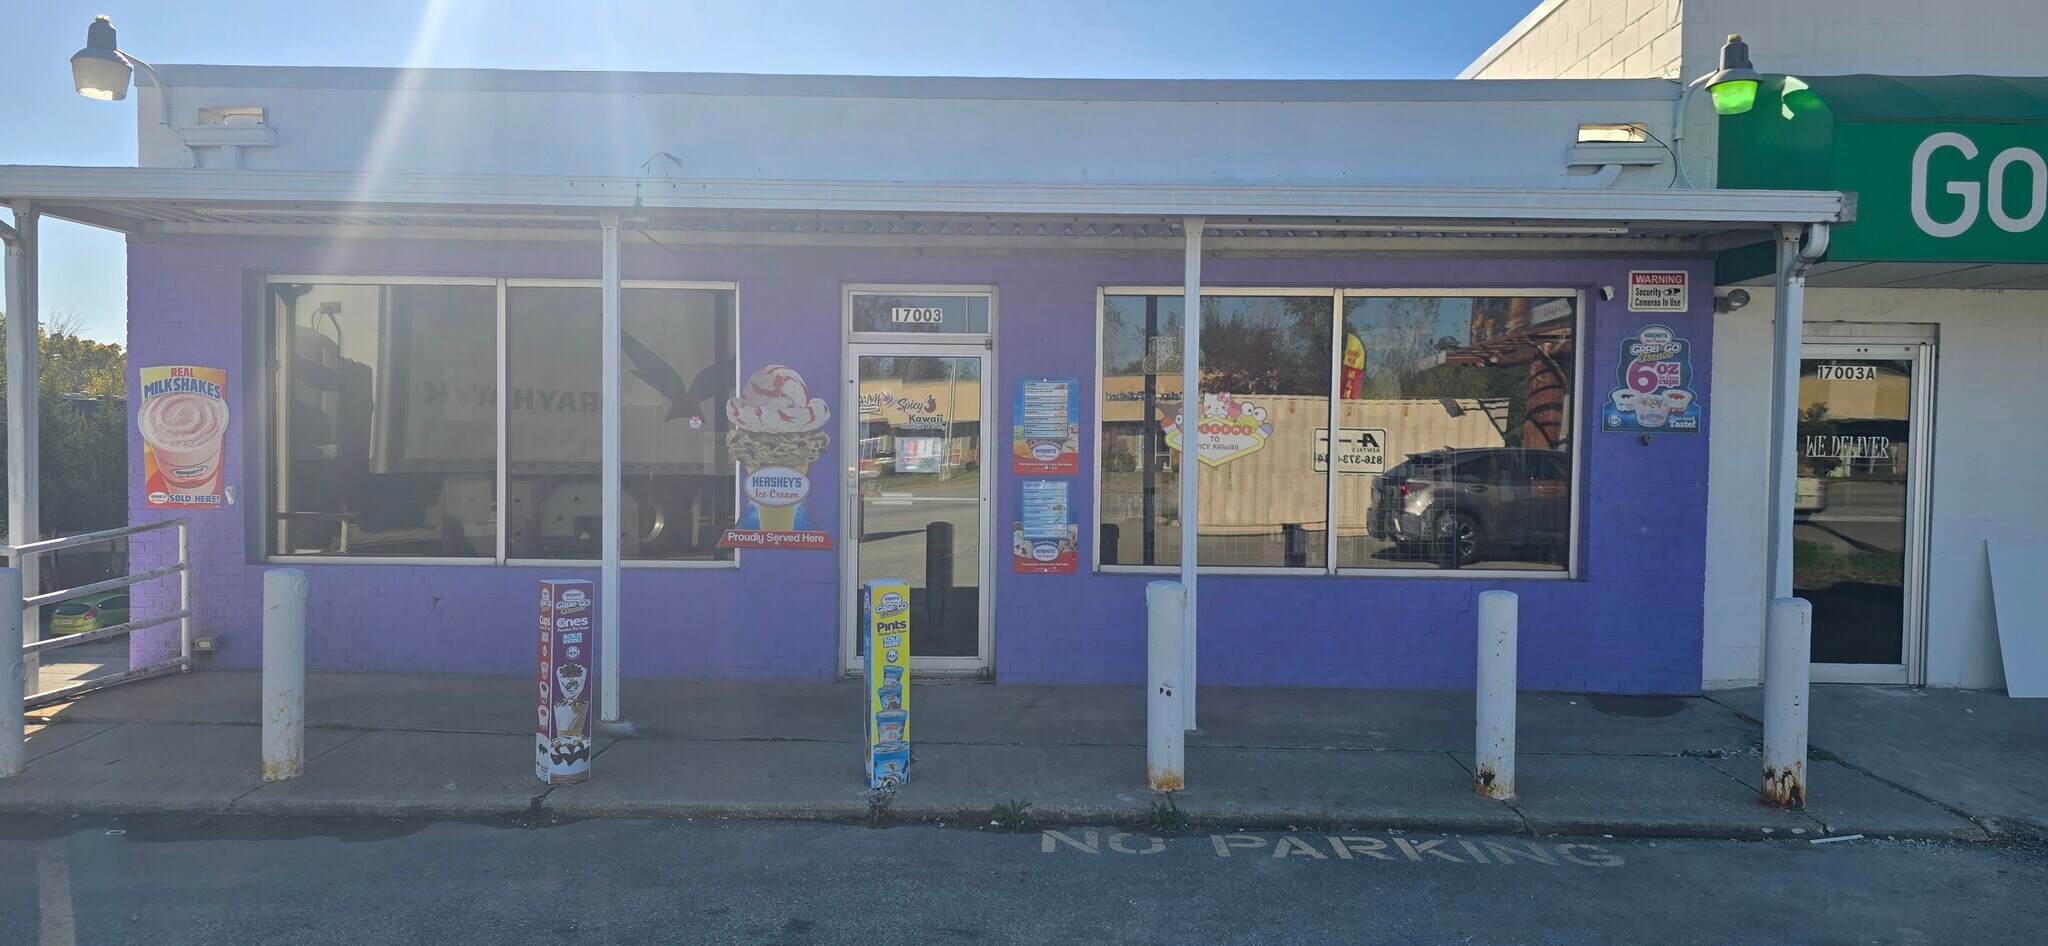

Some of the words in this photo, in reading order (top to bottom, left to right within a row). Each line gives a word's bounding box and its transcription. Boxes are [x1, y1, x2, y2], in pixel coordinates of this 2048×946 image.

[1635, 275, 1683, 284] WARNING
[1635, 287, 1661, 297] Security
[1635, 298, 1661, 307] Cameras
[1670, 299, 1681, 307] Use
[894, 308, 942, 322] 17003
[1632, 345, 1660, 354] GRAB
[1664, 344, 1680, 352] GO
[170, 367, 194, 378] REAL
[1629, 359, 1659, 394] 6
[1819, 366, 1875, 380] 17003A
[144, 377, 222, 400] MILKSHAKES
[1659, 379, 1680, 387] cups
[896, 397, 924, 413] Spicy
[908, 414, 943, 423] Kawaii
[1669, 420, 1696, 429] Taste!
[1210, 435, 1220, 443] TO
[1212, 443, 1239, 451] KAWAII
[1805, 435, 1827, 458] WE
[1831, 435, 1889, 459] DELIVER
[752, 476, 802, 489] HERSHEY'S
[169, 494, 192, 503] SOLD
[194, 495, 220, 503] HERE!
[755, 488, 769, 499] Ice
[769, 488, 800, 500] Cream
[727, 532, 764, 544] Proudly
[766, 533, 800, 543] Served
[802, 533, 824, 543] Here
[540, 615, 551, 627] Cups
[876, 620, 907, 633] Pints
[1041, 828, 1167, 855] NO
[1210, 833, 1626, 867] PARKING
